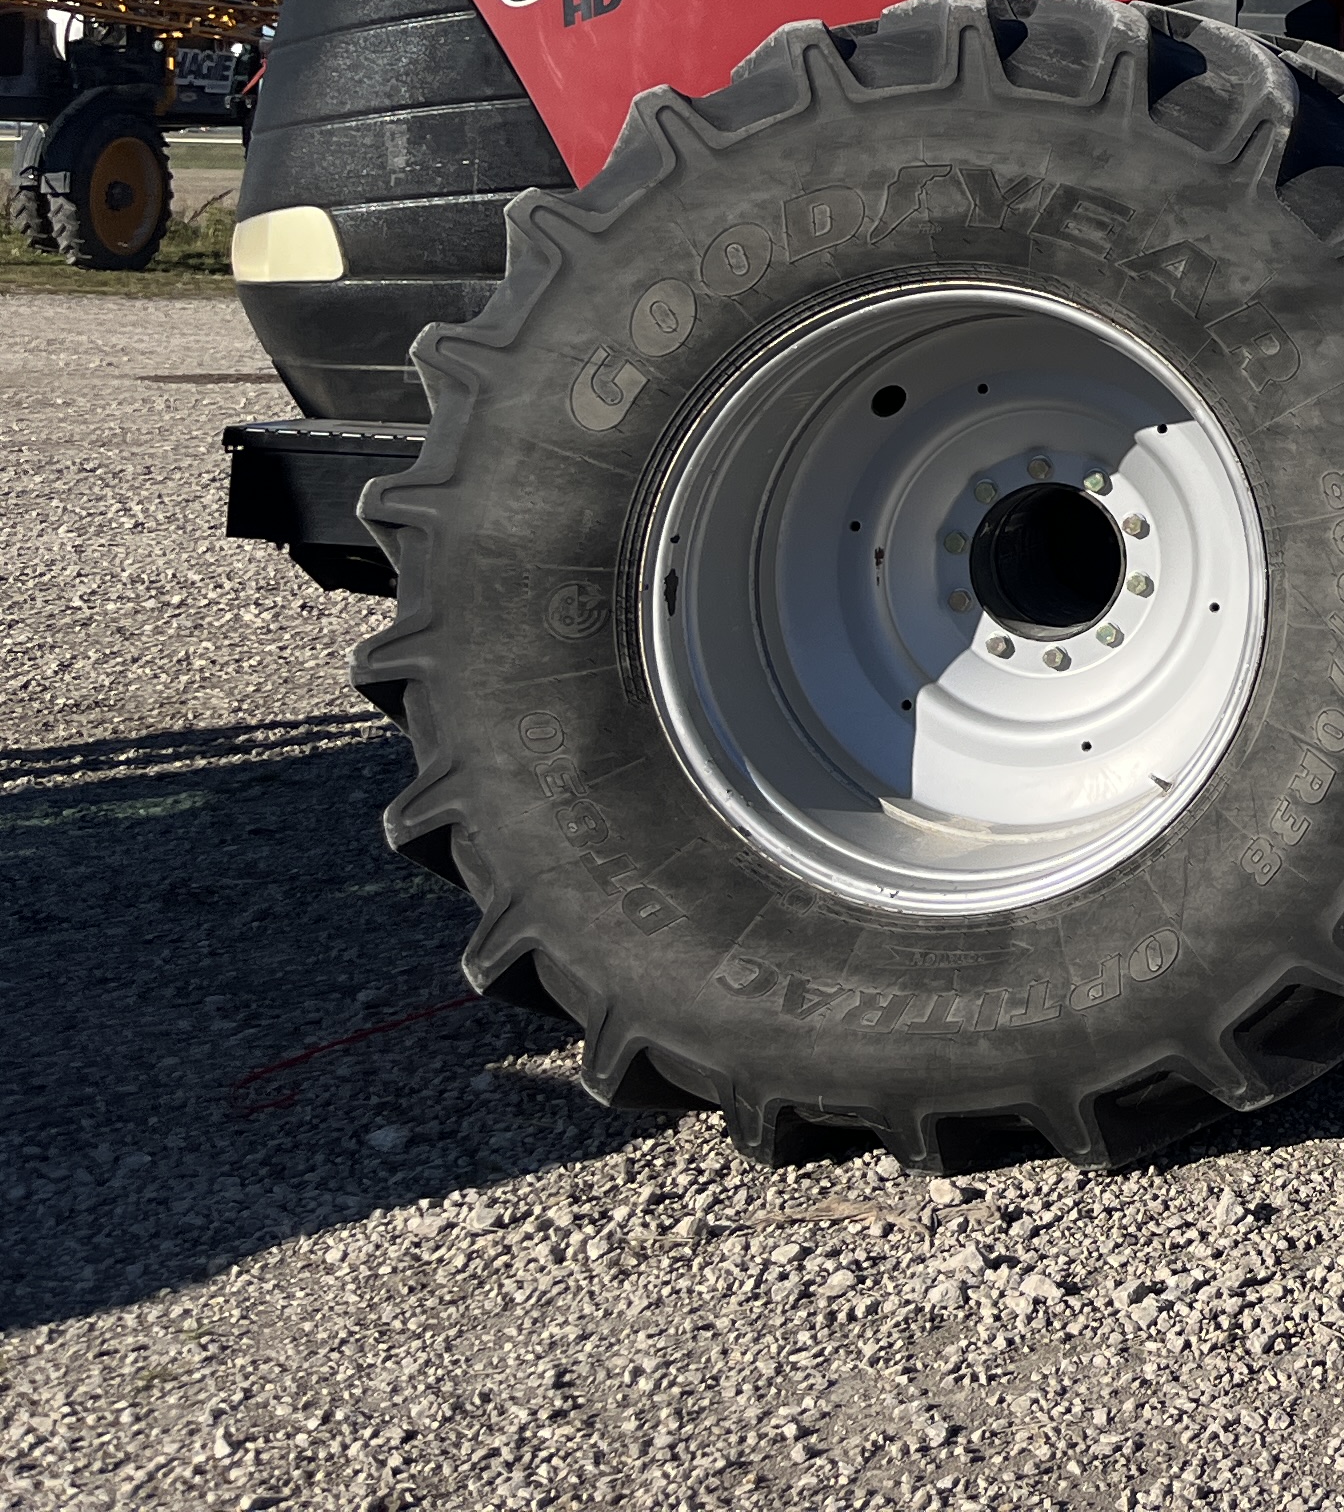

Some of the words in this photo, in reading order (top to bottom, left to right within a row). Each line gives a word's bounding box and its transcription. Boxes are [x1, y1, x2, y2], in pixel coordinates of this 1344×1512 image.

[570, 164, 1303, 431] GOODYEAR
[518, 710, 688, 940] DT830
[713, 928, 1182, 1037] OPTITRAC
